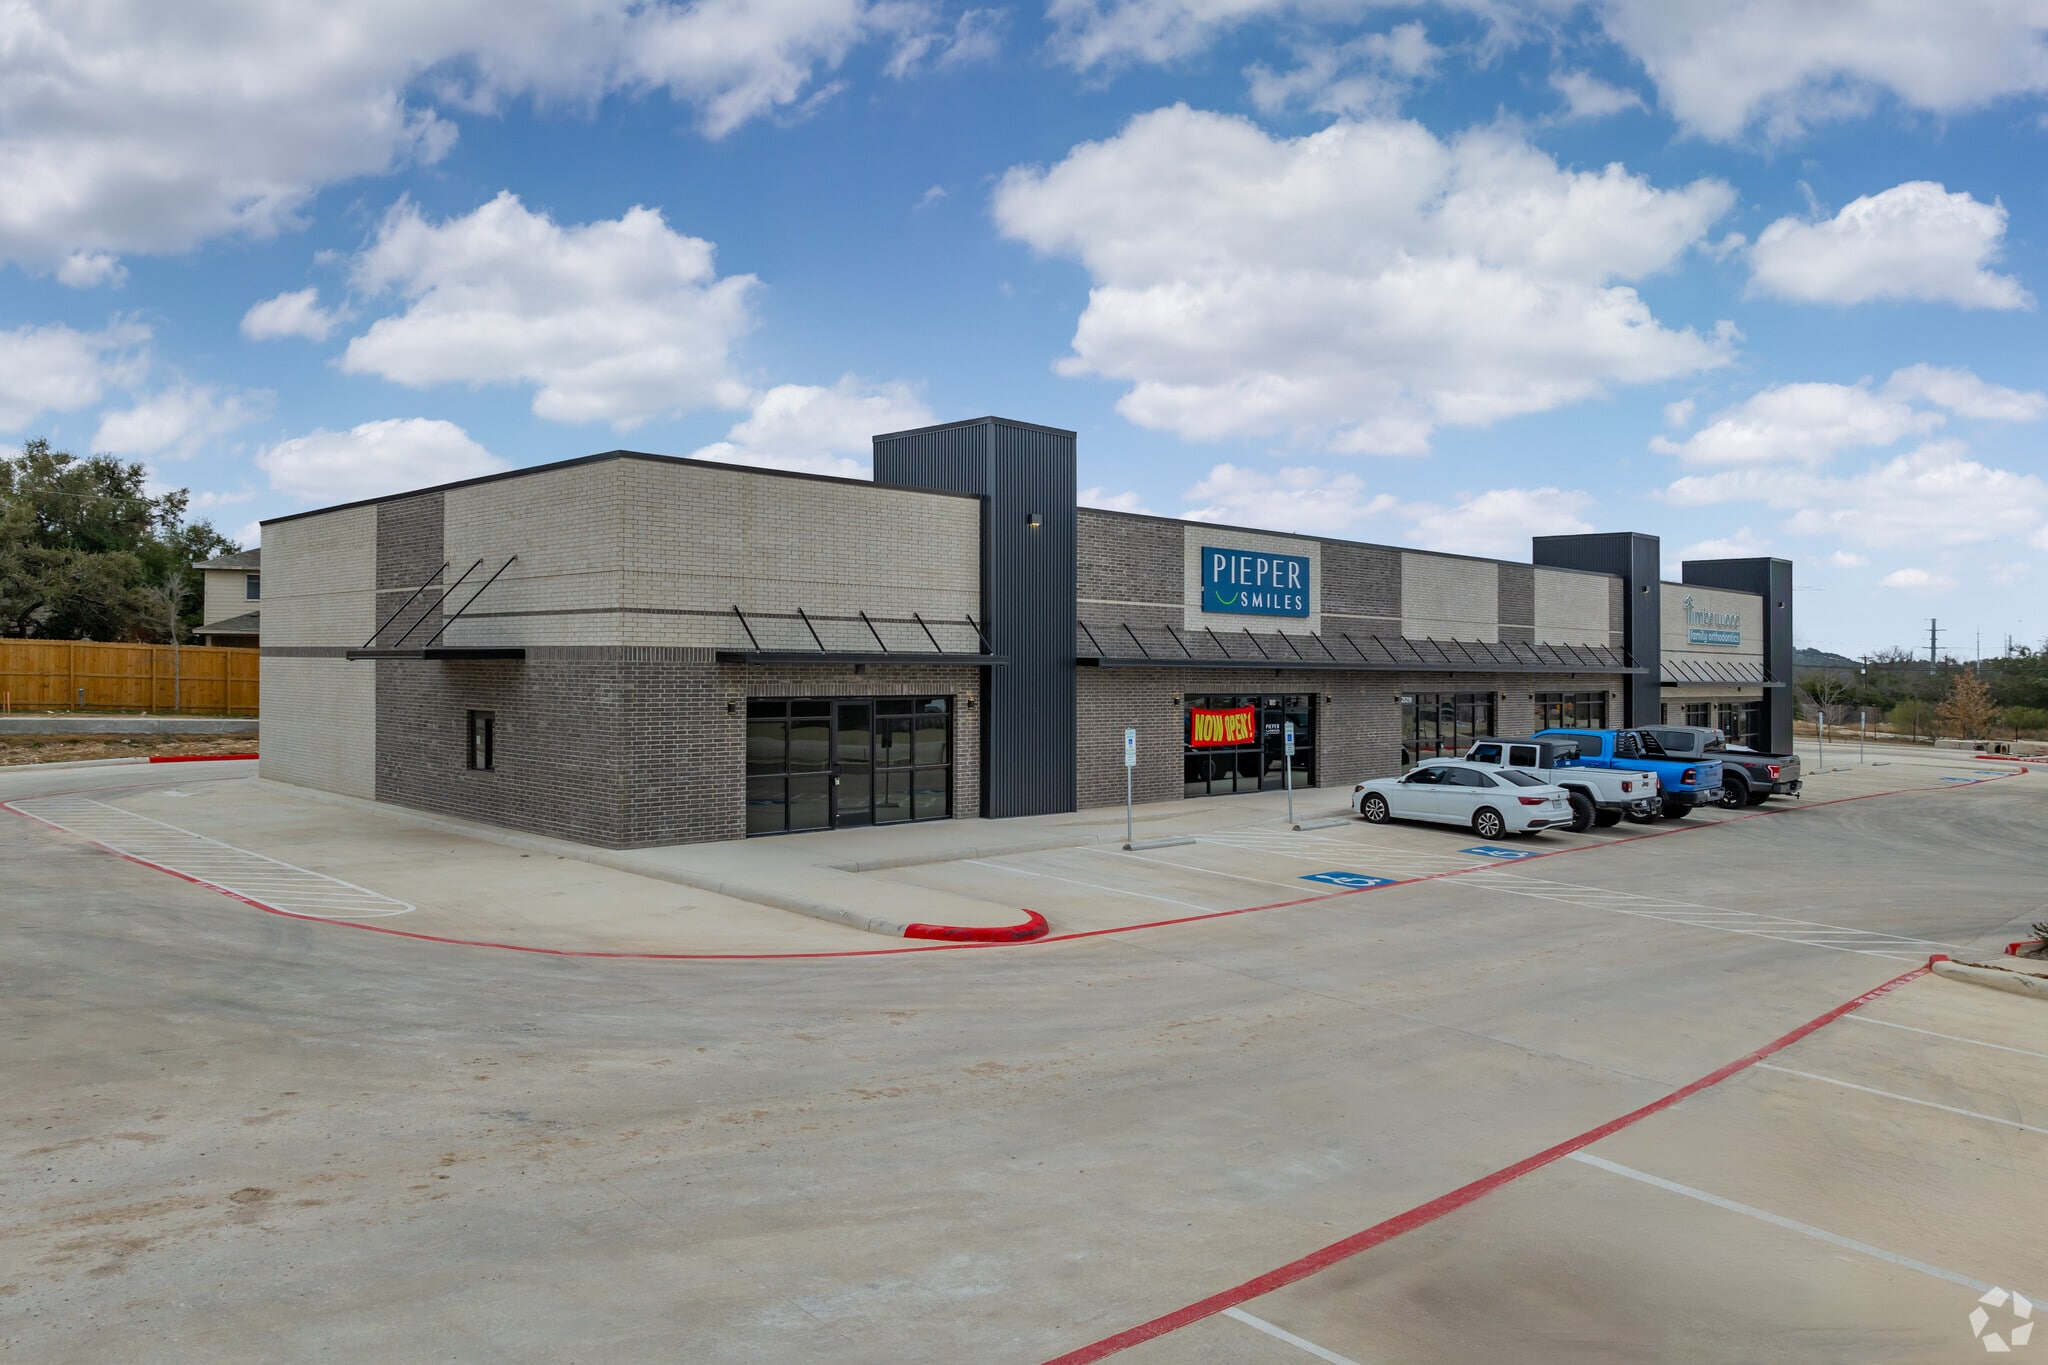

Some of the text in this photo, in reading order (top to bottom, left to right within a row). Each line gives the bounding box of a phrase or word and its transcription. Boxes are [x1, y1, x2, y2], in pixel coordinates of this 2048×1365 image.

[1213, 554, 1301, 589] PIEPER
[1241, 591, 1302, 610] SMILES
[1690, 630, 1739, 643] family orthodontics
[1195, 712, 1253, 742] NOW OPEN!
